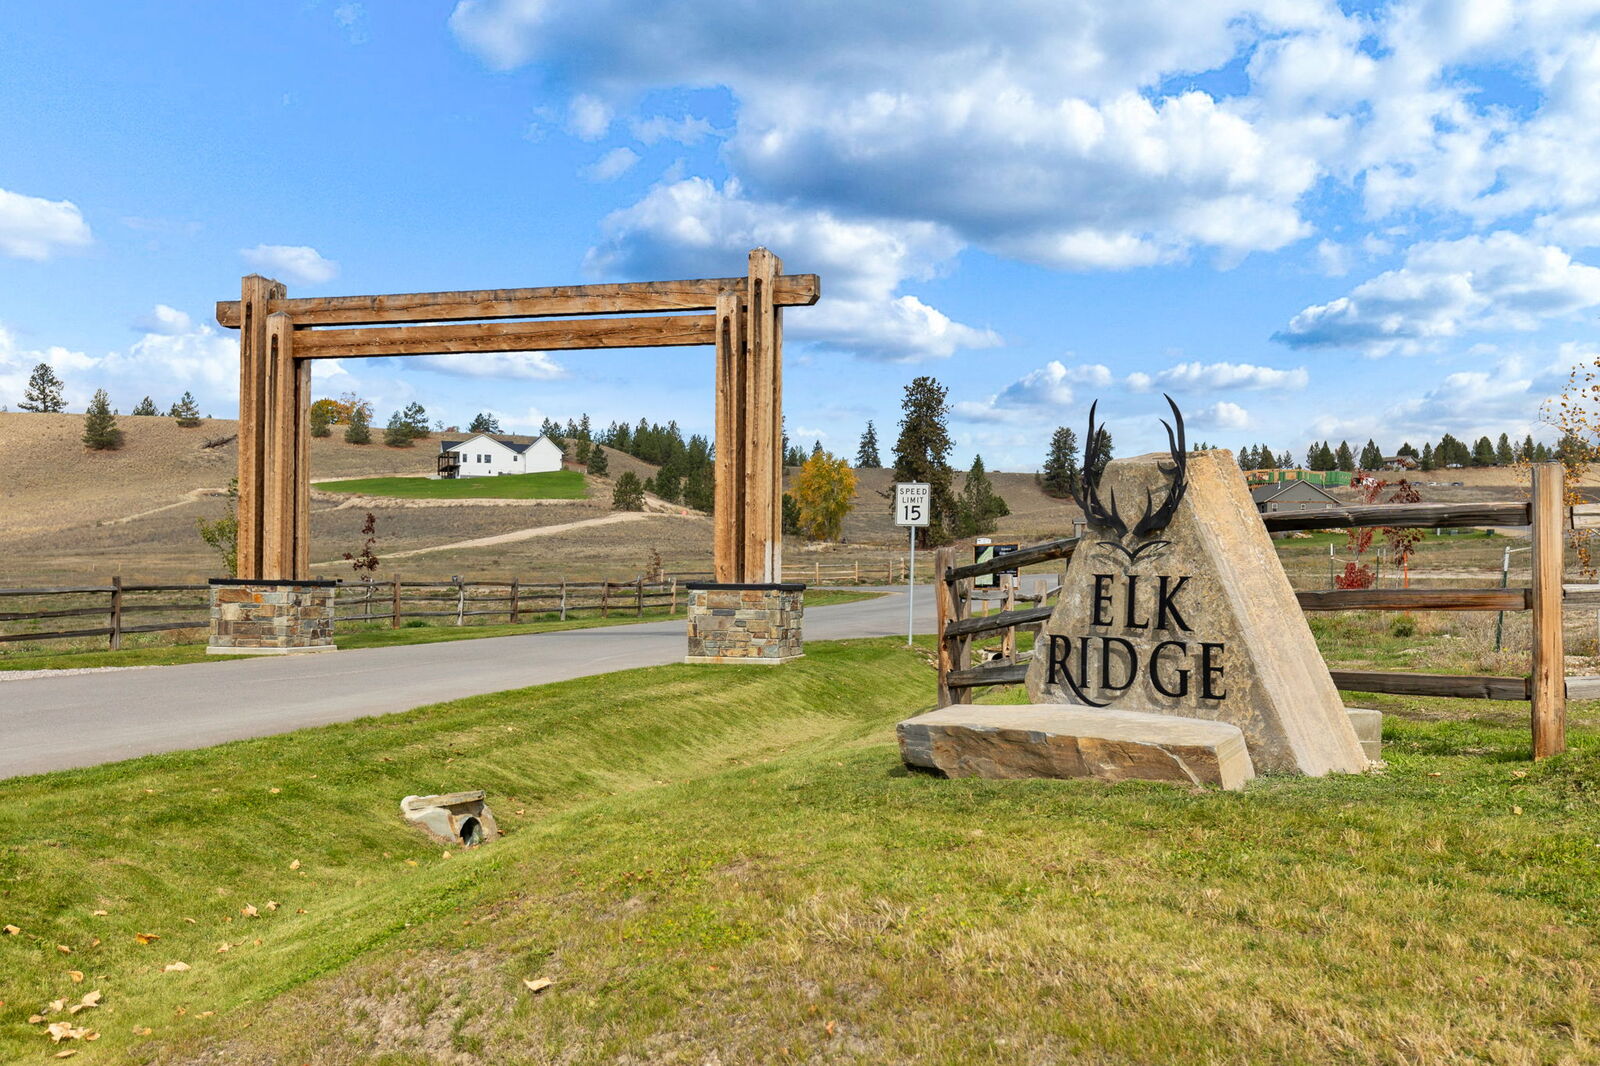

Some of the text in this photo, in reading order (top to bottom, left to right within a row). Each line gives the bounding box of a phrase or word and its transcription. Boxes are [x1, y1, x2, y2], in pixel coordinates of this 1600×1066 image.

[899, 488, 928, 496] SPEED
[902, 496, 924, 504] LIMIT
[904, 505, 921, 521] 15
[1091, 573, 1194, 632] ELK
[1046, 634, 1227, 708] RIDGE
